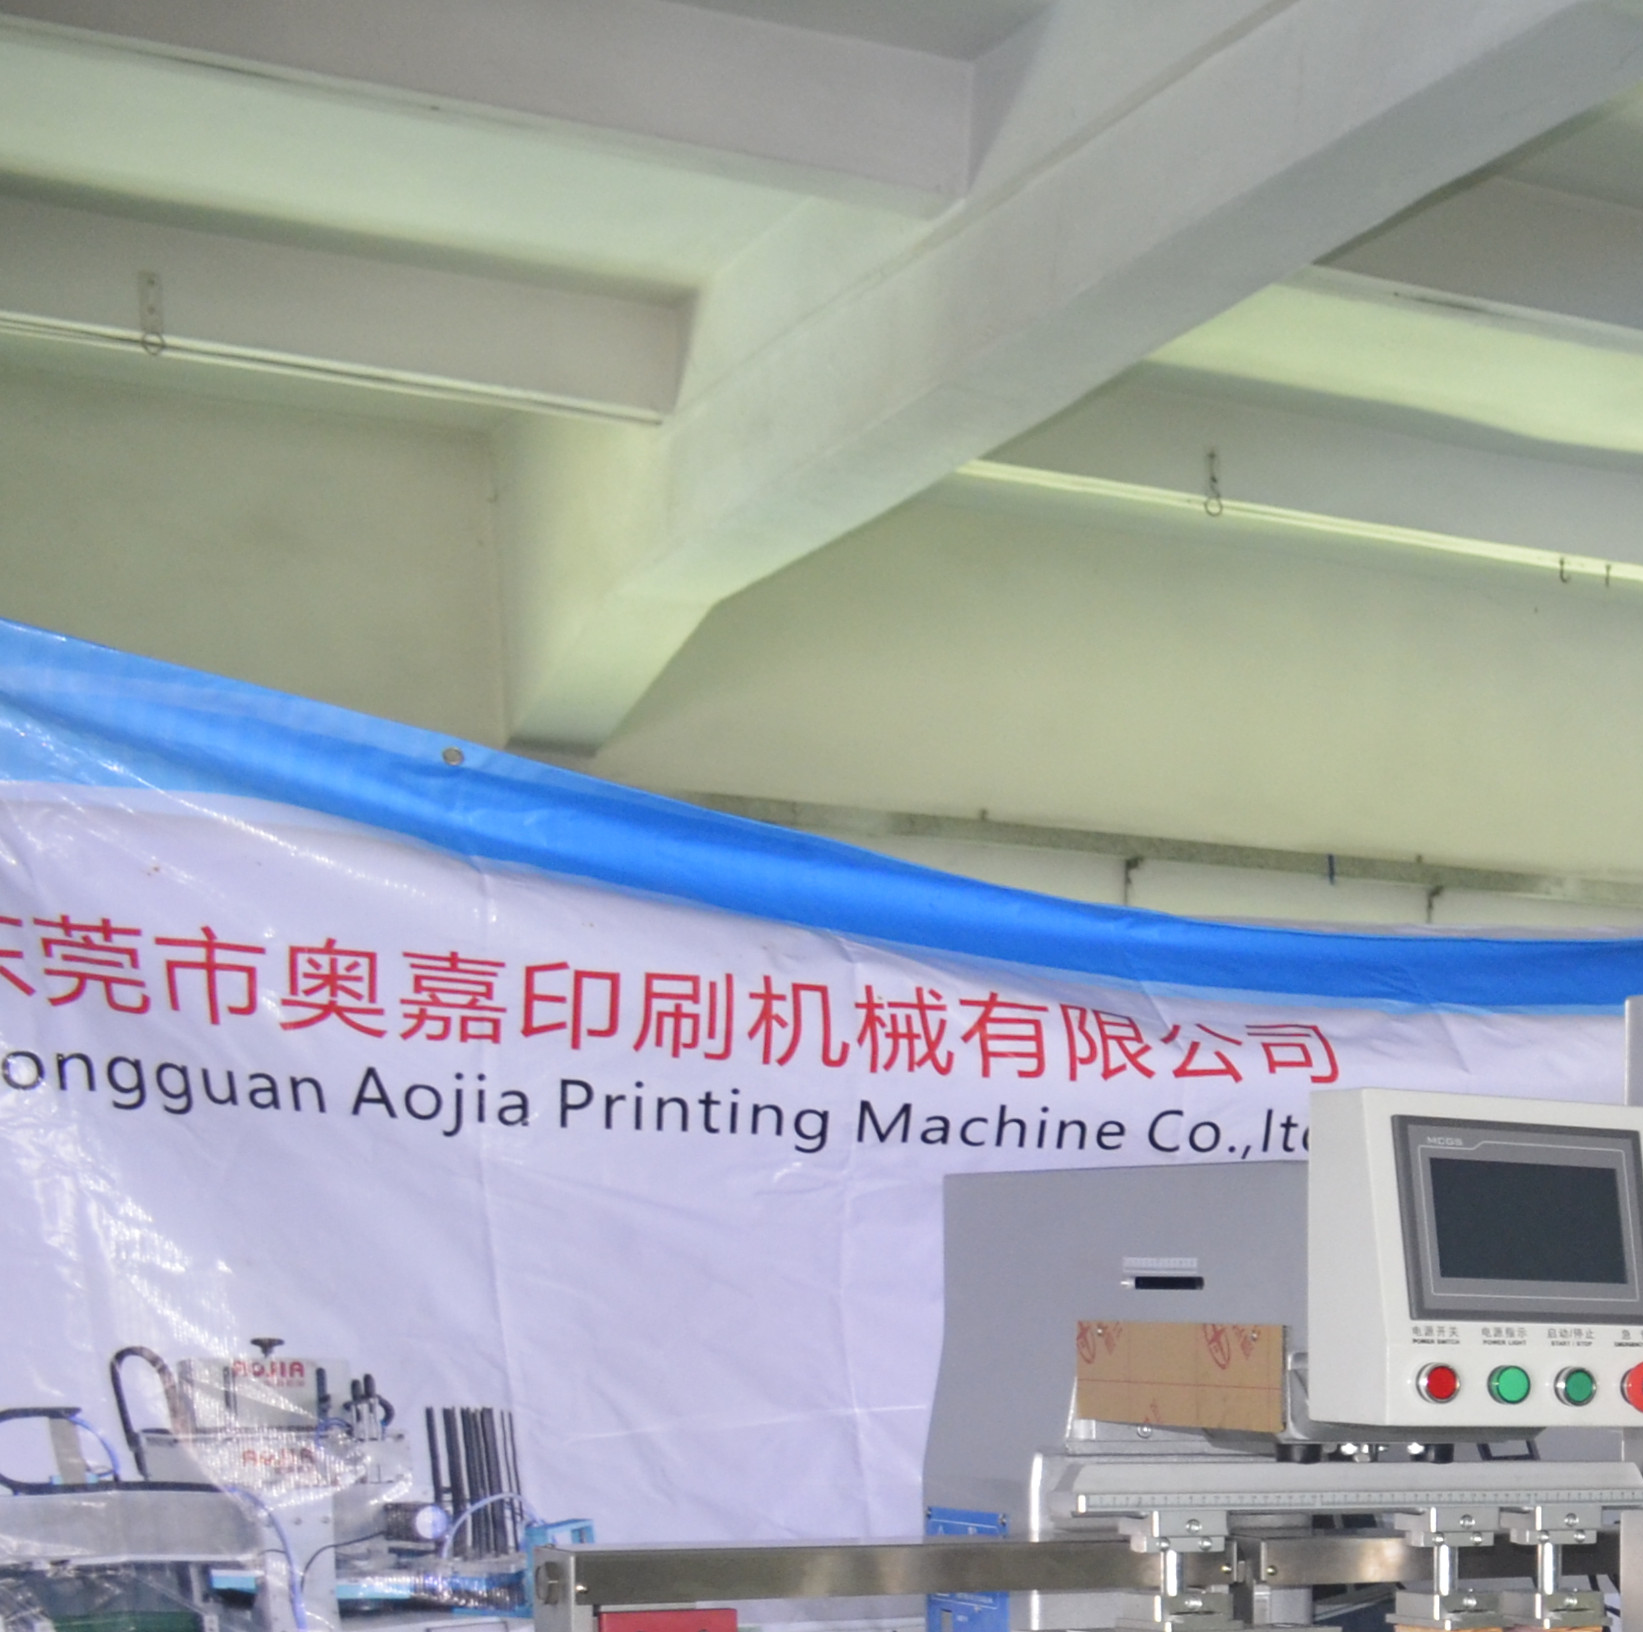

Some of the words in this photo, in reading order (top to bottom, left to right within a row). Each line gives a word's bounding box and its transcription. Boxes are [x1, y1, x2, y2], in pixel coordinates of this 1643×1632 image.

[351, 1066, 531, 1137] Aojia
[559, 1078, 829, 1154] Printing
[856, 1099, 1127, 1152] Machine
